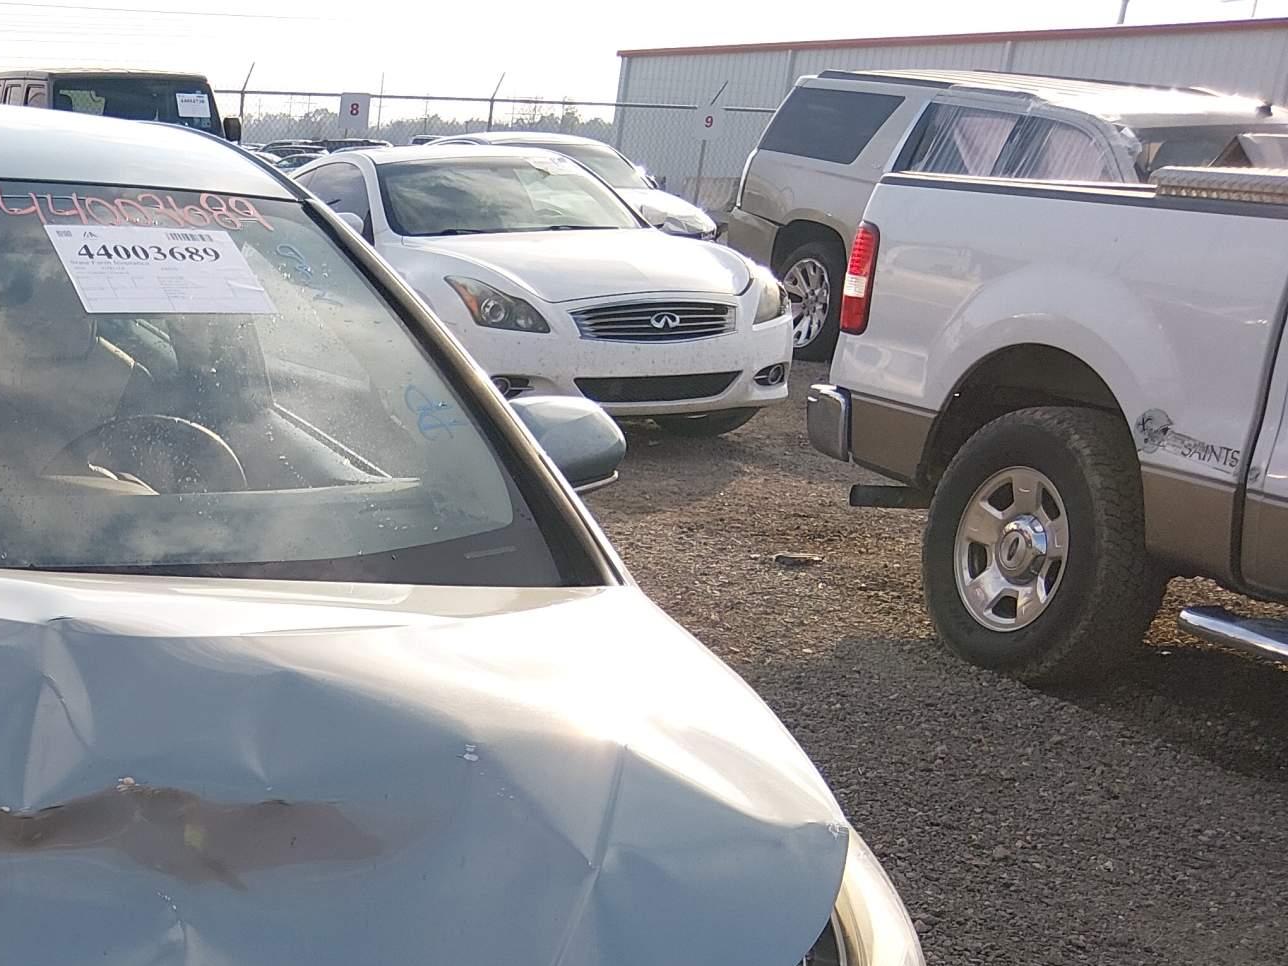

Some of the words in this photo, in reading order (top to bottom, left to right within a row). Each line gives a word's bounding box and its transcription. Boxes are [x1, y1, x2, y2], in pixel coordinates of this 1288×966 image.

[350, 103, 360, 117] 8
[704, 115, 714, 129] 9
[78, 243, 221, 262] 44003689
[1180, 441, 1241, 468] SAINTS
